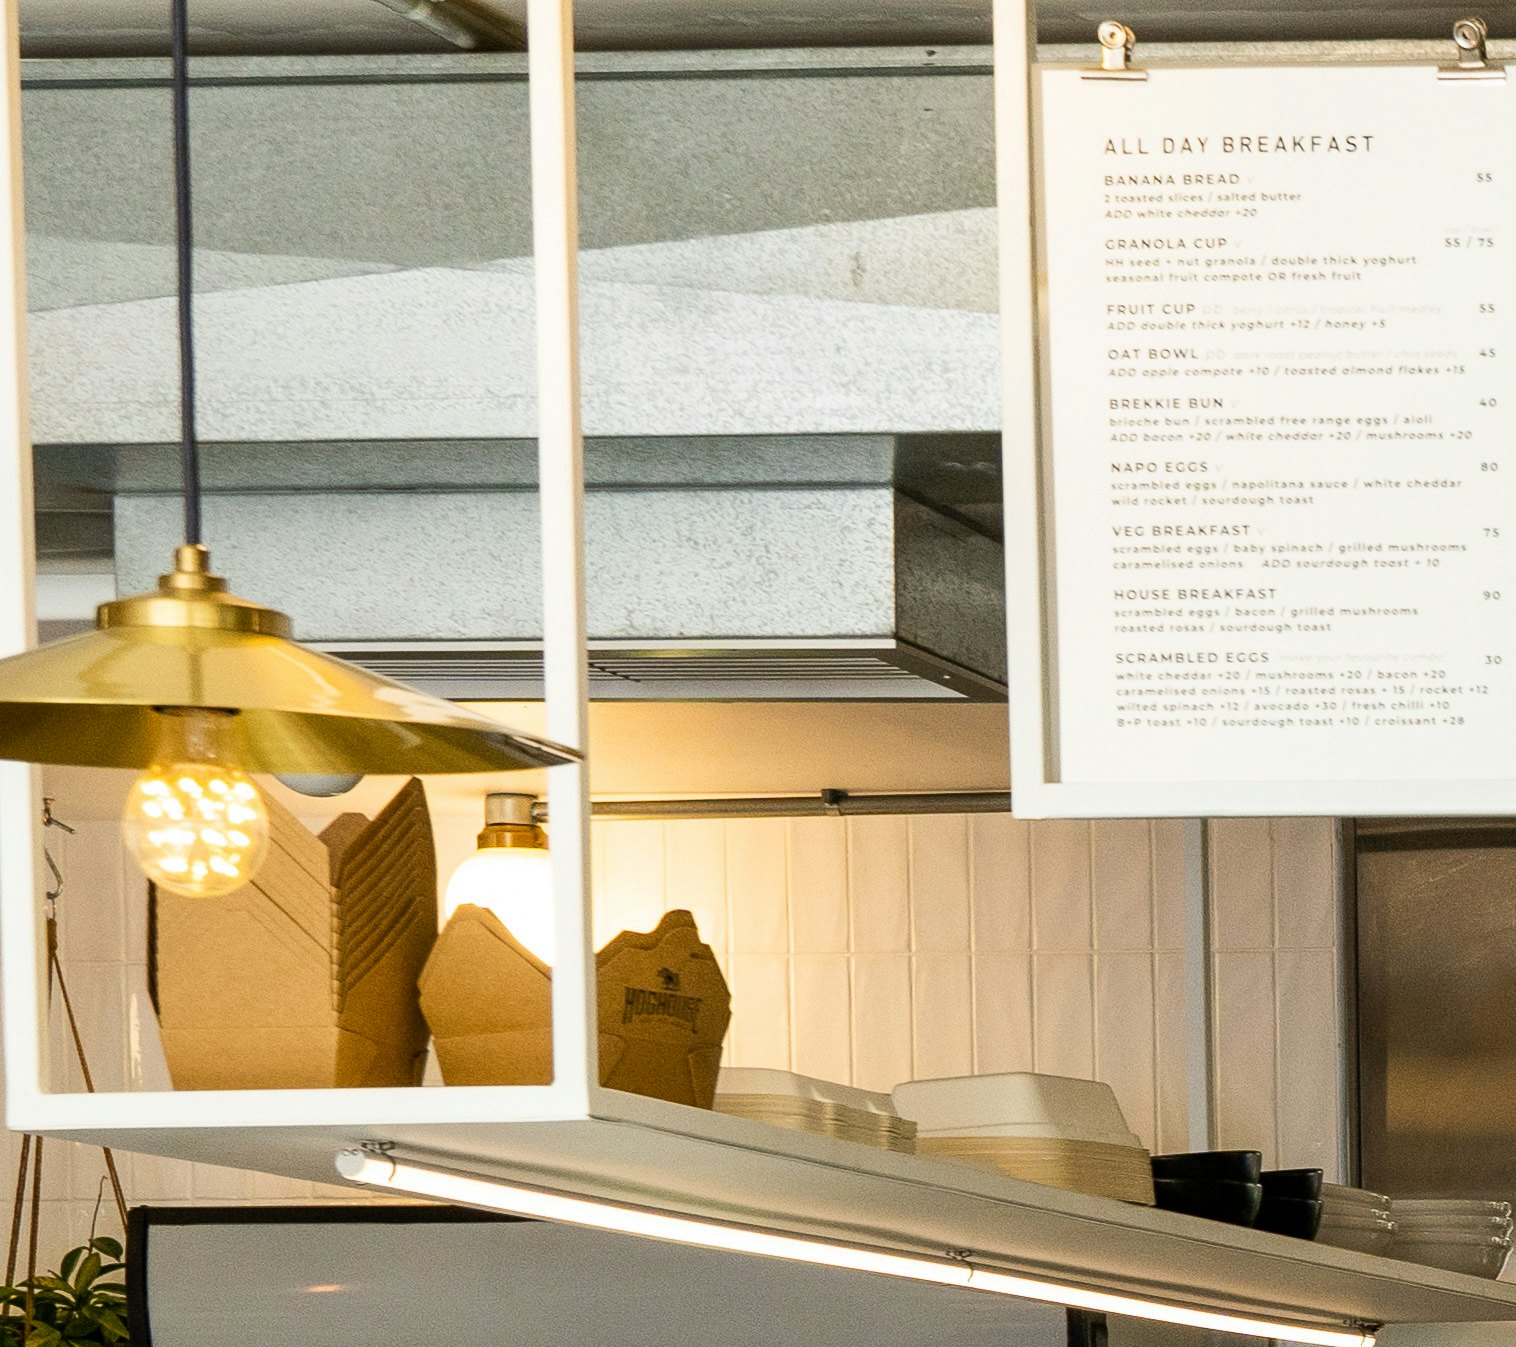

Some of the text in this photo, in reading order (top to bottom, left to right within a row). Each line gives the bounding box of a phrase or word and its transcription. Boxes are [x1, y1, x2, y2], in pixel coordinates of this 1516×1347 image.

[1105, 135, 1373, 154] ALL DAY BREAKFAST
[1105, 174, 1239, 186] BANANA BREAD
[1477, 173, 1492, 182] 55
[1105, 238, 1227, 250] GRANOLA CUP
[1106, 271, 1361, 282] seasonal fruit compote OR fresh fruit
[1110, 398, 1223, 410] BREKKIE BUN
[1112, 525, 1250, 537] VEG BREAKFAST
[1114, 588, 1276, 600] HOUSE BREAKFAST
